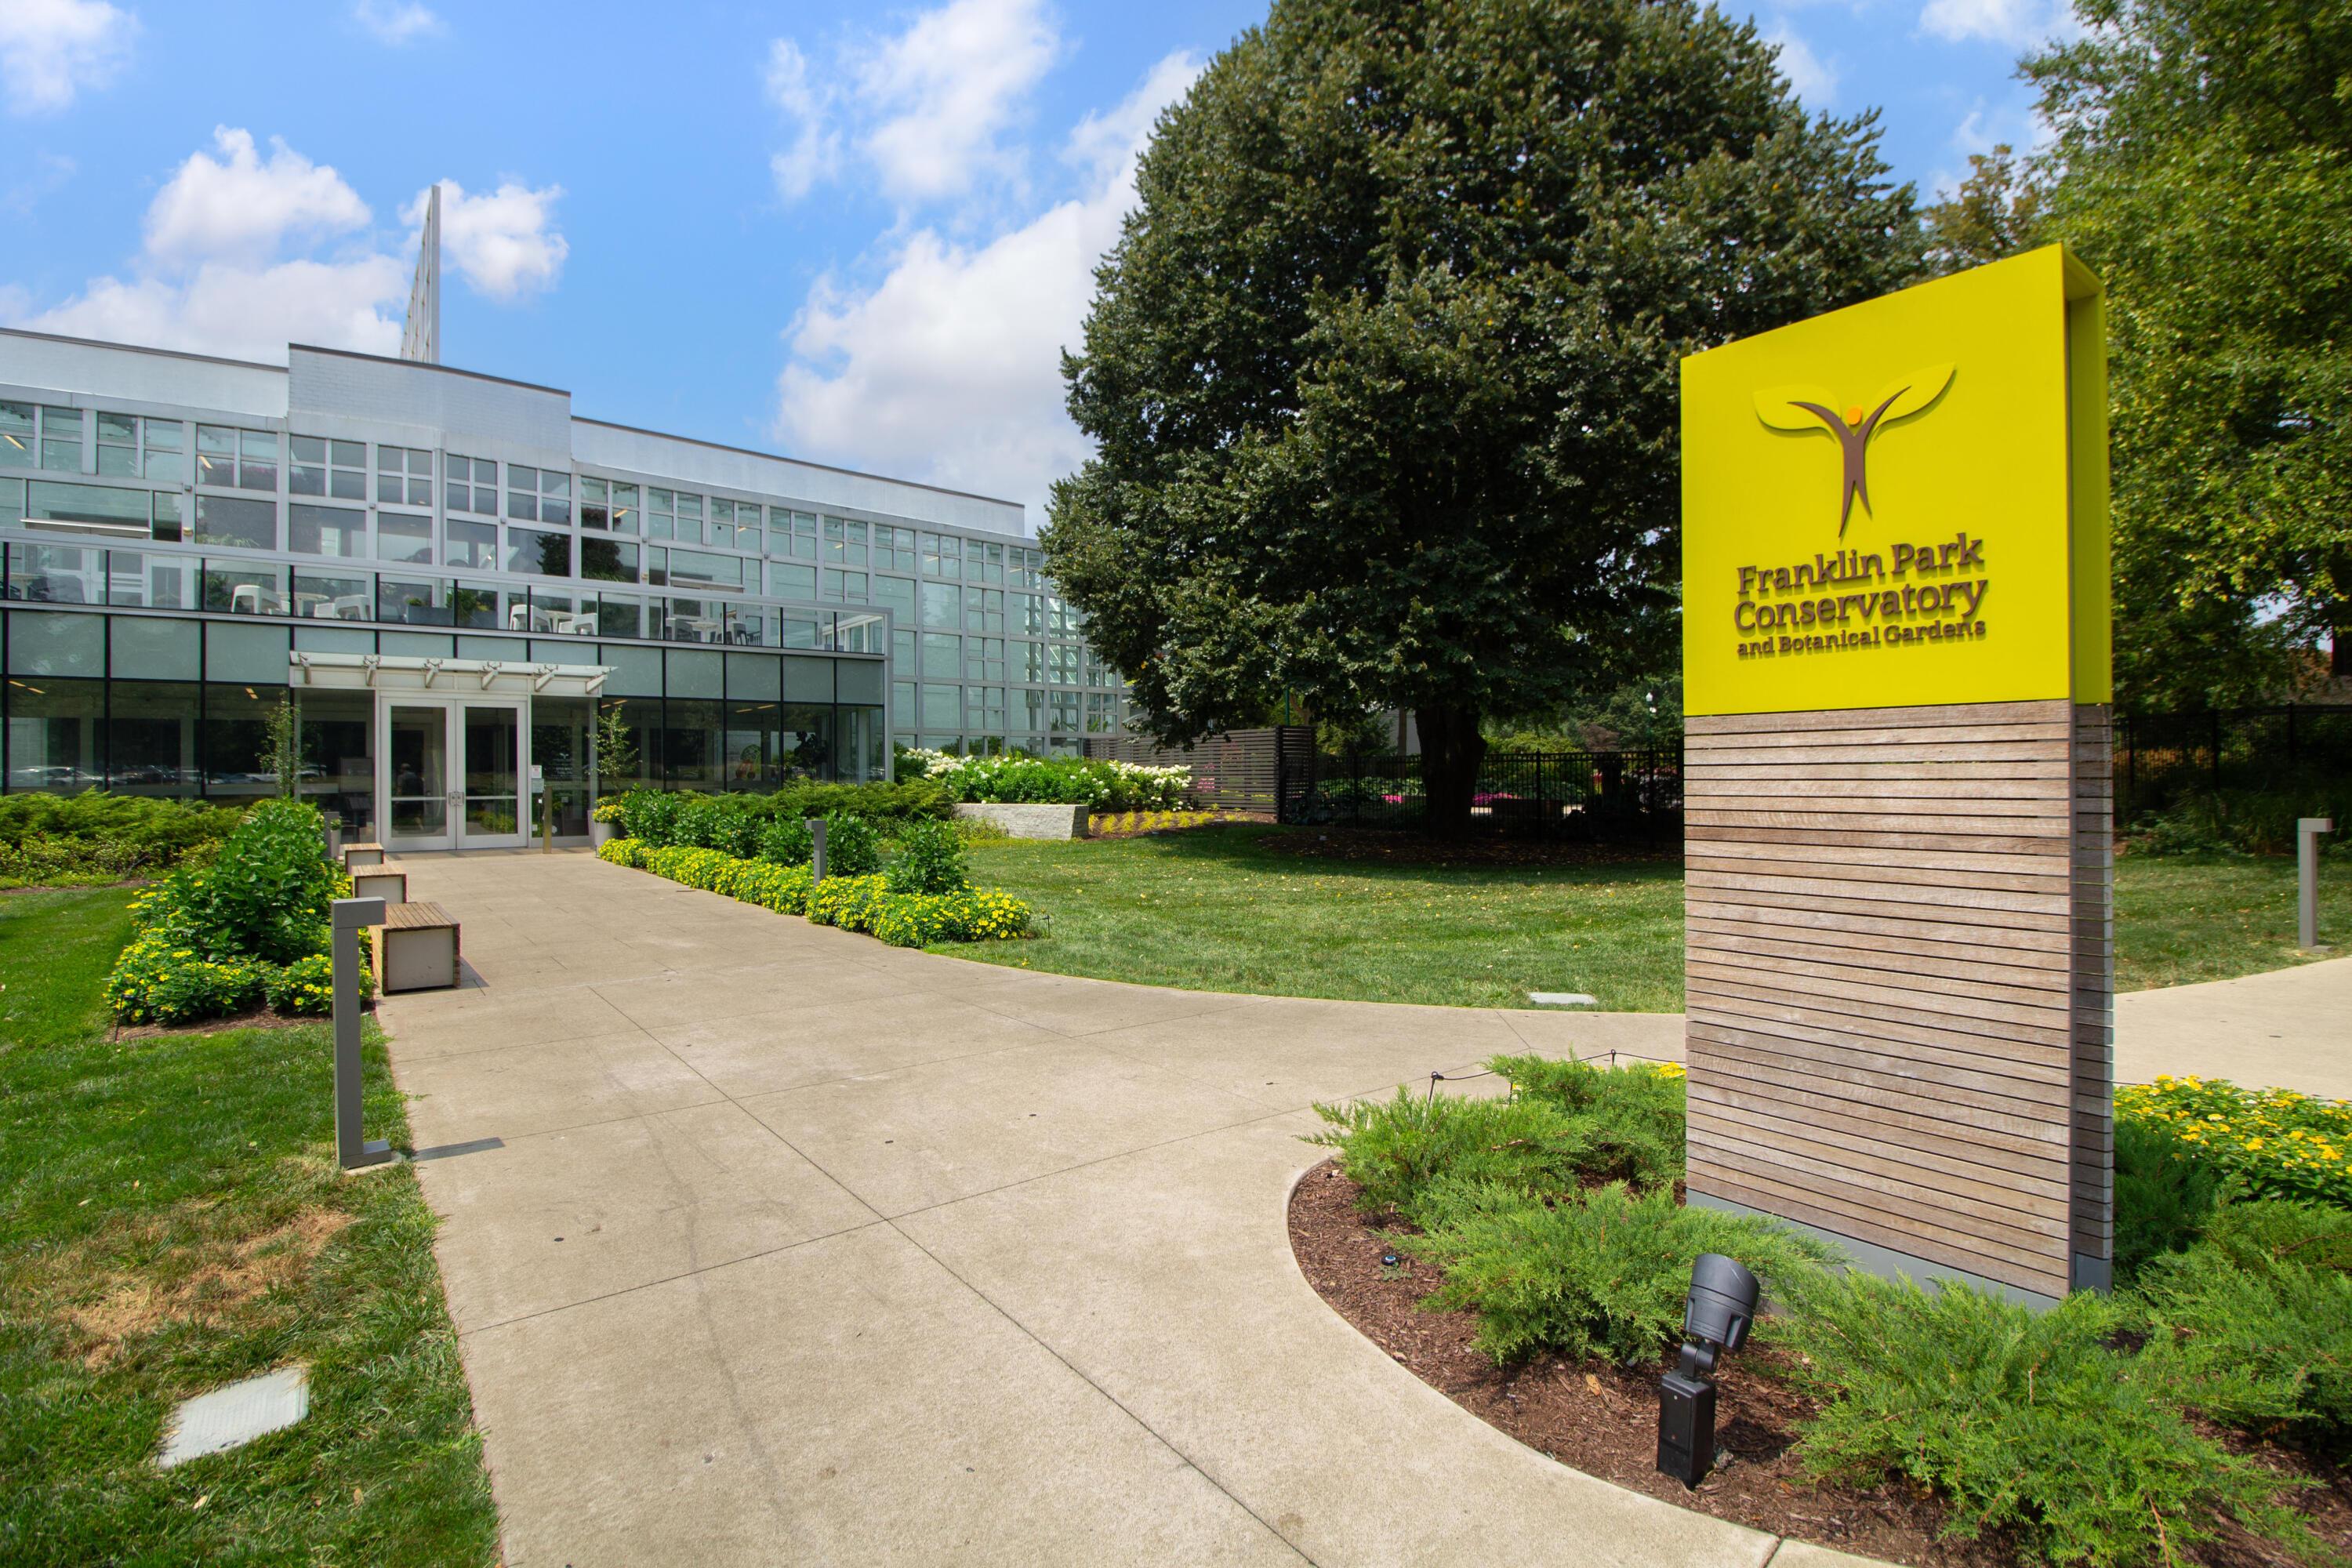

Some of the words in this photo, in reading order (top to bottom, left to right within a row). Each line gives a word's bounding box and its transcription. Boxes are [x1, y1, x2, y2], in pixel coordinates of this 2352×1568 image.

[1737, 549, 1885, 594] Franklin
[1890, 532, 1984, 574] Park
[1734, 579, 1988, 630] Conservatory
[1737, 637, 1775, 655] and
[1778, 630, 1881, 652] Botanical
[1883, 620, 1986, 642] Gardens
